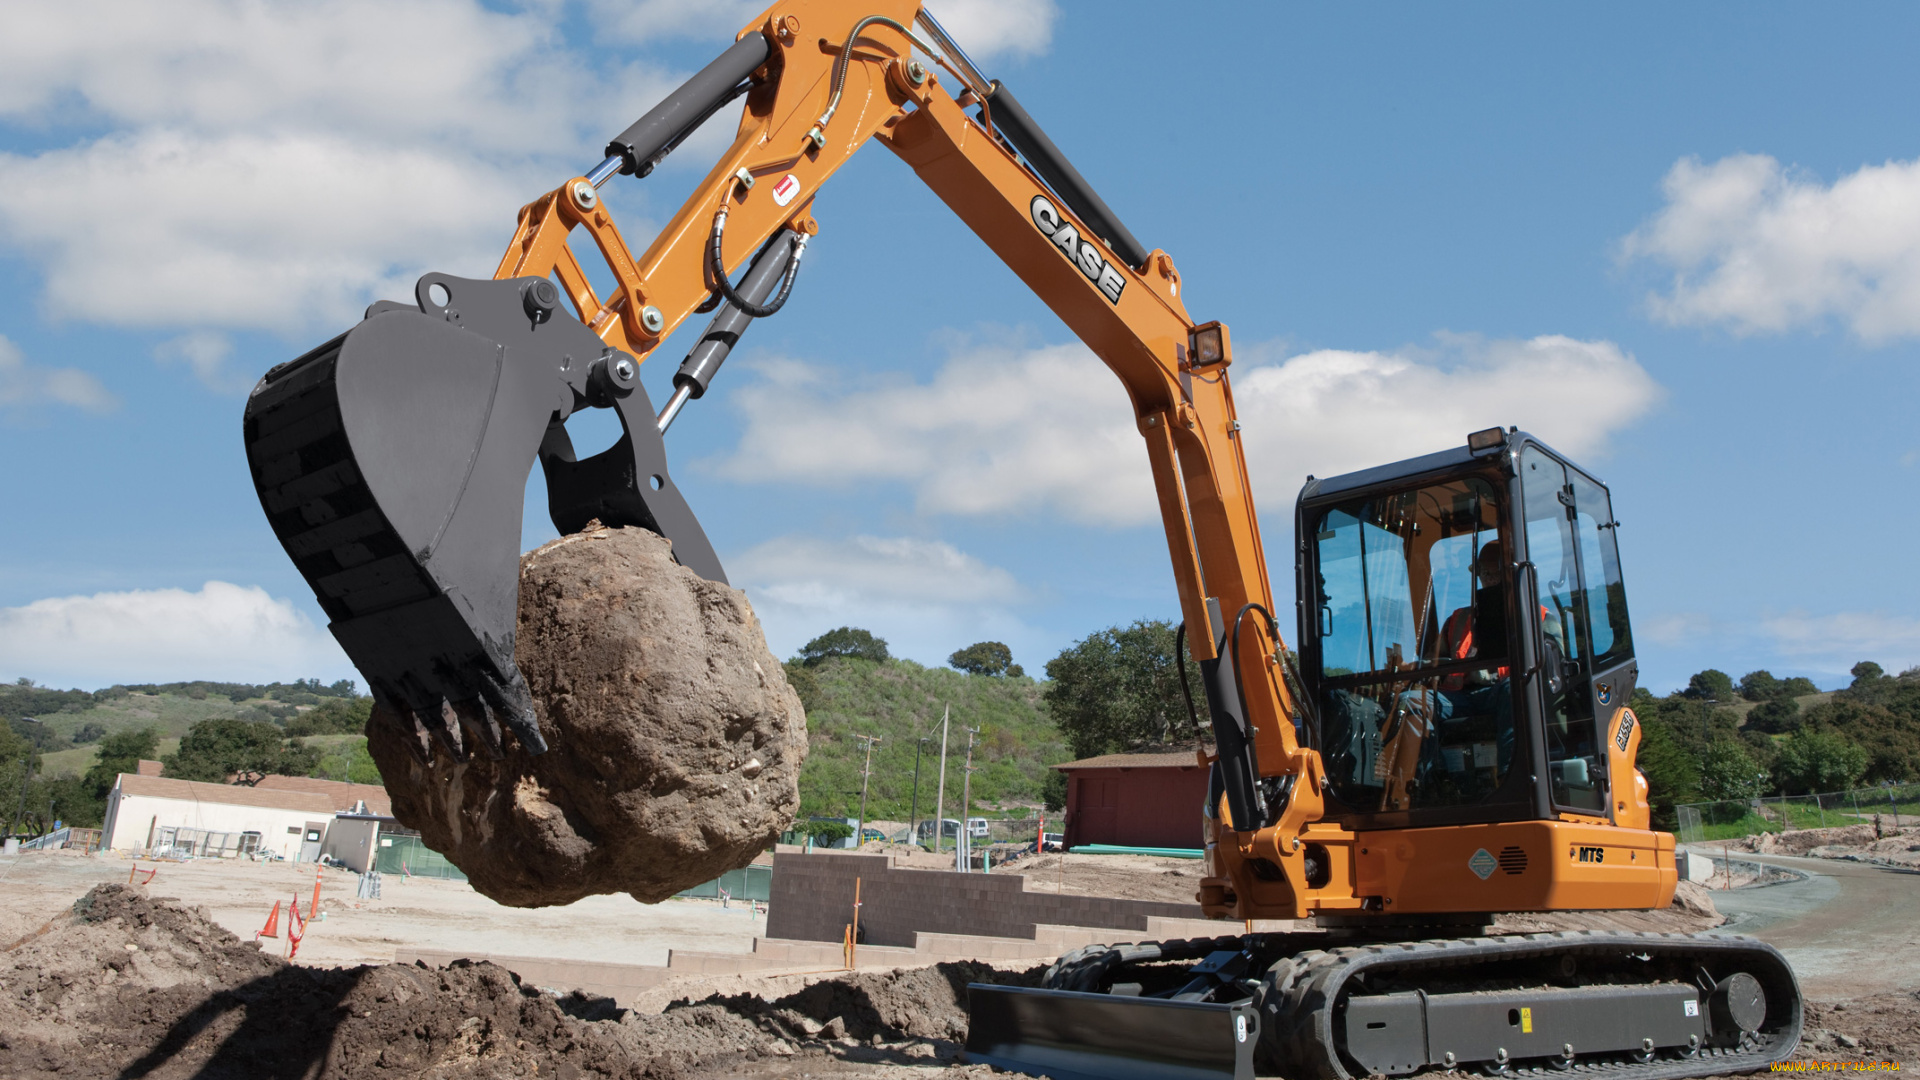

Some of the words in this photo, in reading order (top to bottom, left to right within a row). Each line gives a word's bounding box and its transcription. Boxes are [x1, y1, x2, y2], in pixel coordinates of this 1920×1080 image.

[1030, 195, 1126, 305] CASE
[1616, 711, 1634, 751] CX55B
[1579, 847, 1604, 863] MTS
